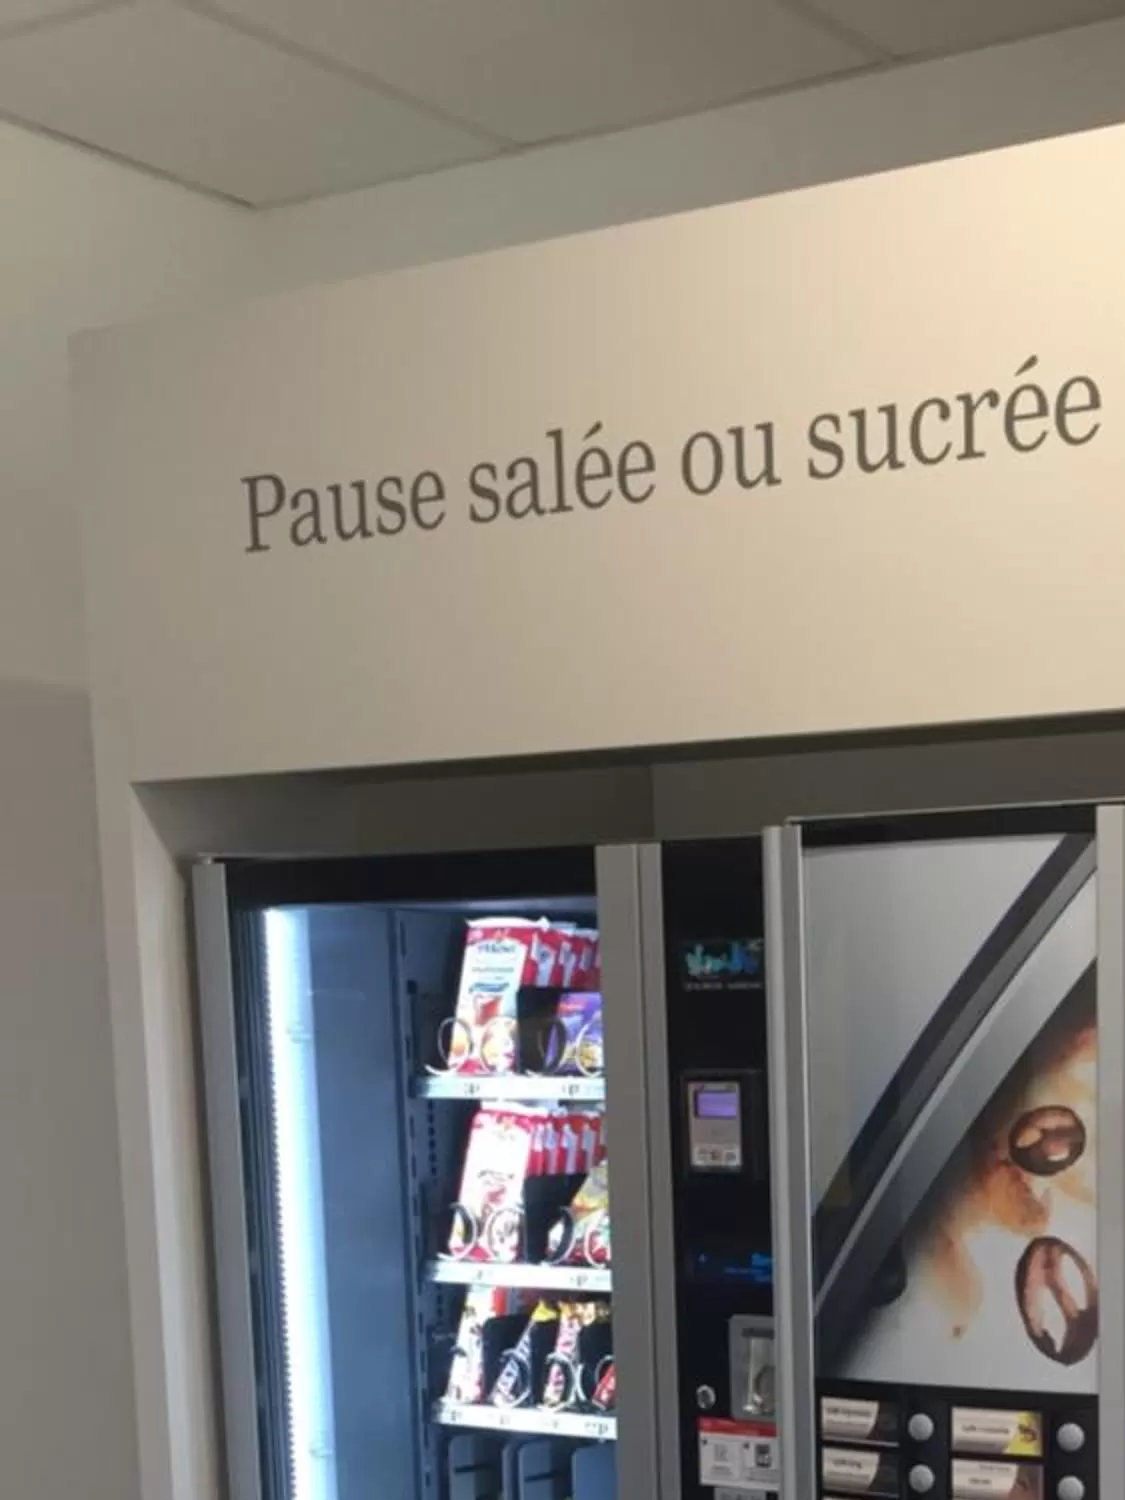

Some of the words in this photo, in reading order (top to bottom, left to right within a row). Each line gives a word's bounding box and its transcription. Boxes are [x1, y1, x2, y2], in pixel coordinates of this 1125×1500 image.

[240, 471, 446, 553] Pause
[468, 421, 656, 524] salée
[681, 422, 783, 496] ou
[807, 355, 1102, 481] sucrée
